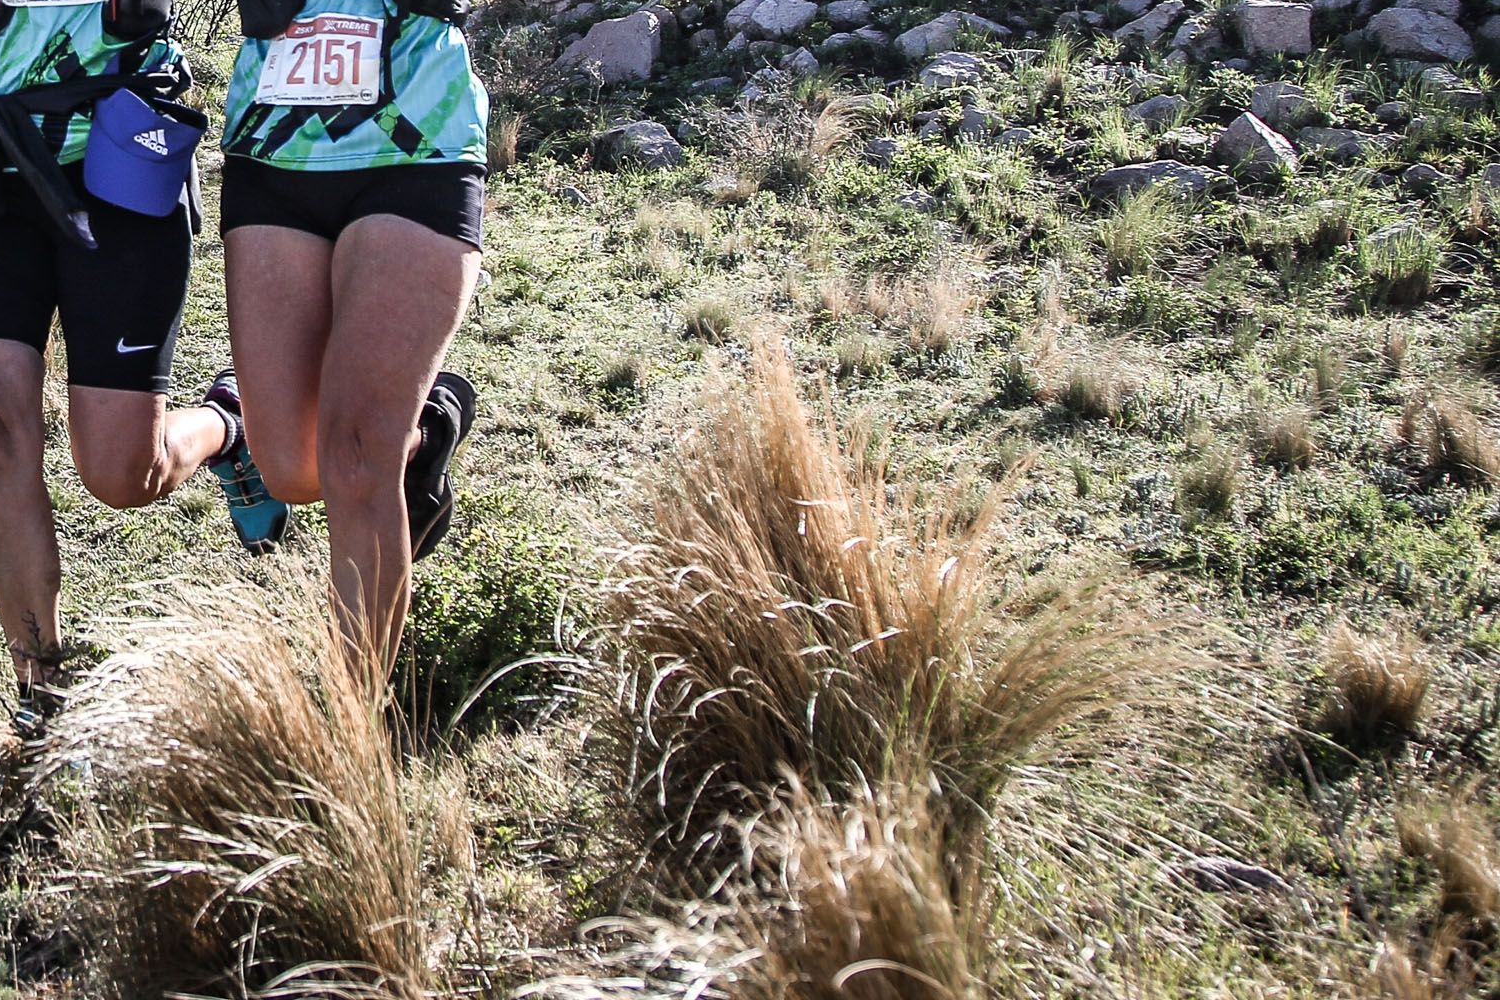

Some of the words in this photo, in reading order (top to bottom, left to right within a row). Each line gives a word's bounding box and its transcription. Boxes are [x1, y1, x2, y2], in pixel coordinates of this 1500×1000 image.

[323, 19, 371, 31] XTREME
[286, 40, 362, 85] 2151
[134, 135, 168, 155] adidas
